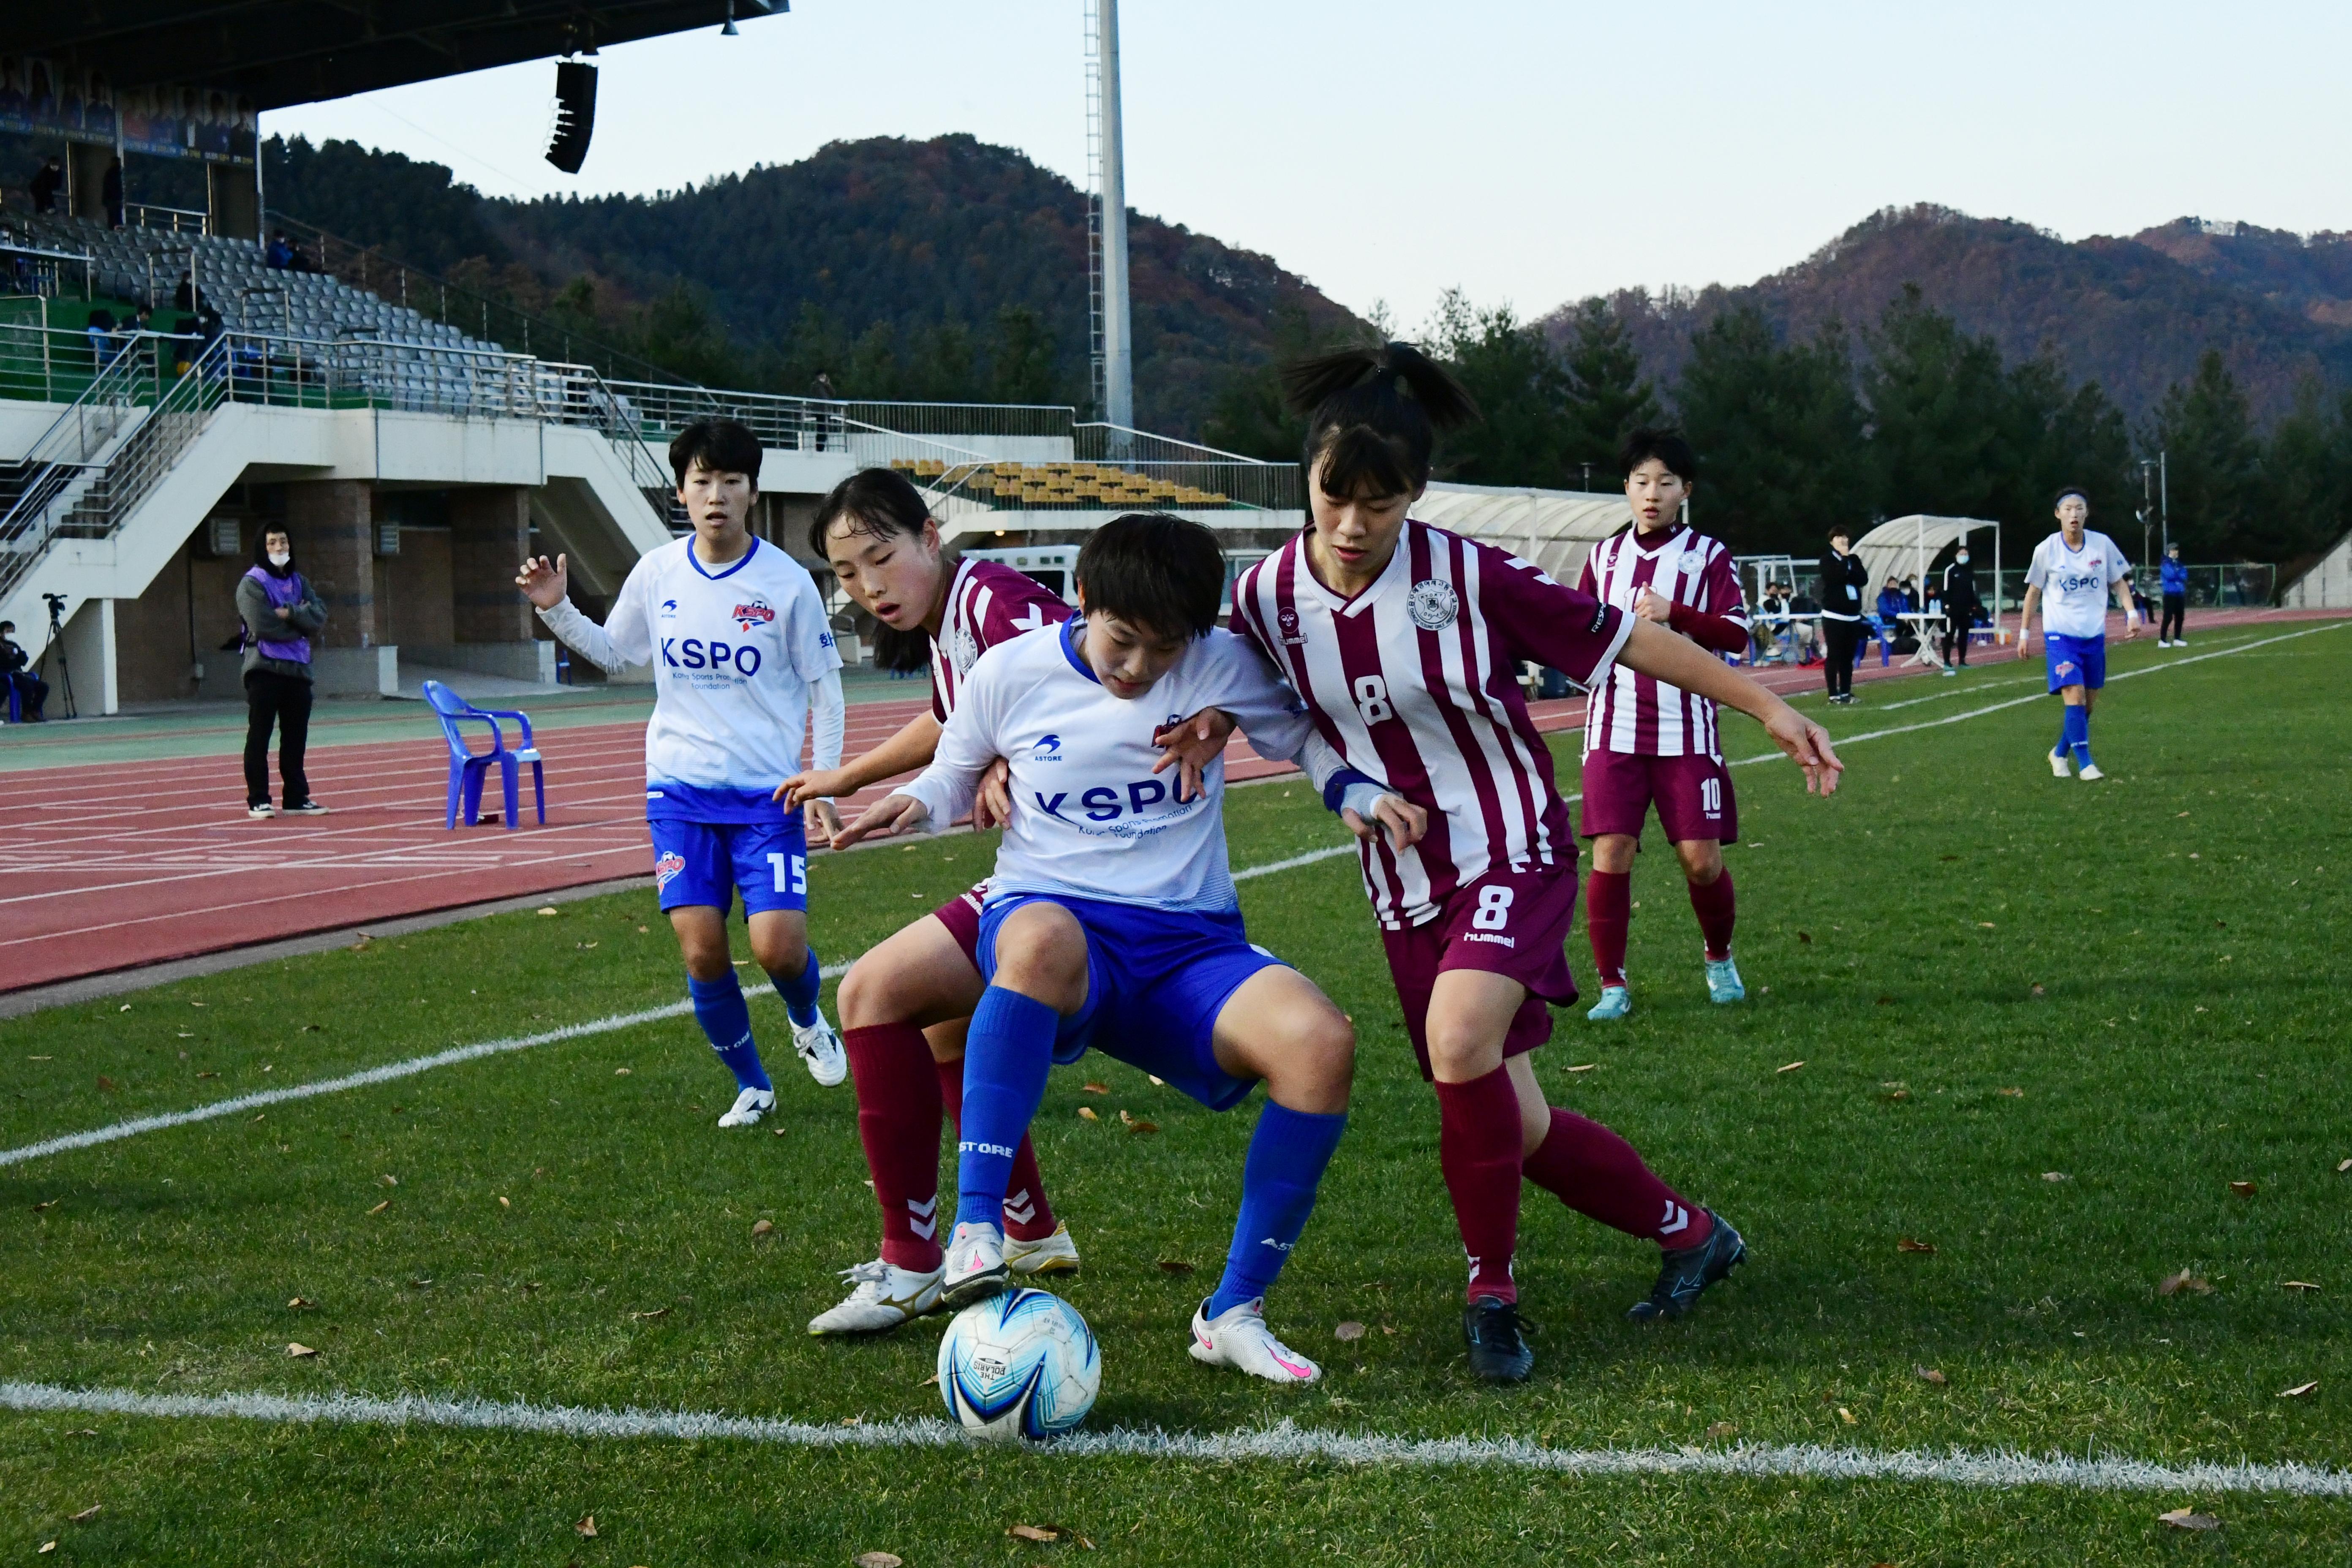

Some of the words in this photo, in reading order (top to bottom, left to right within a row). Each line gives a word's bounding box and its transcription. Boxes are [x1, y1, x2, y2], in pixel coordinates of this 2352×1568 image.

[2059, 577, 2099, 591] KSPO
[731, 604, 776, 621] KSPO
[1277, 632, 1308, 646] hummel
[661, 637, 761, 677] KSPO
[1354, 675, 1393, 726] 8
[1701, 778, 1720, 811] 10
[656, 855, 685, 874] SPO
[767, 852, 807, 895] 15
[1472, 885, 1514, 930] 8
[1464, 932, 1514, 948] hummel
[974, 1361, 1006, 1375] POLARIS
[980, 1372, 994, 1380] THE
